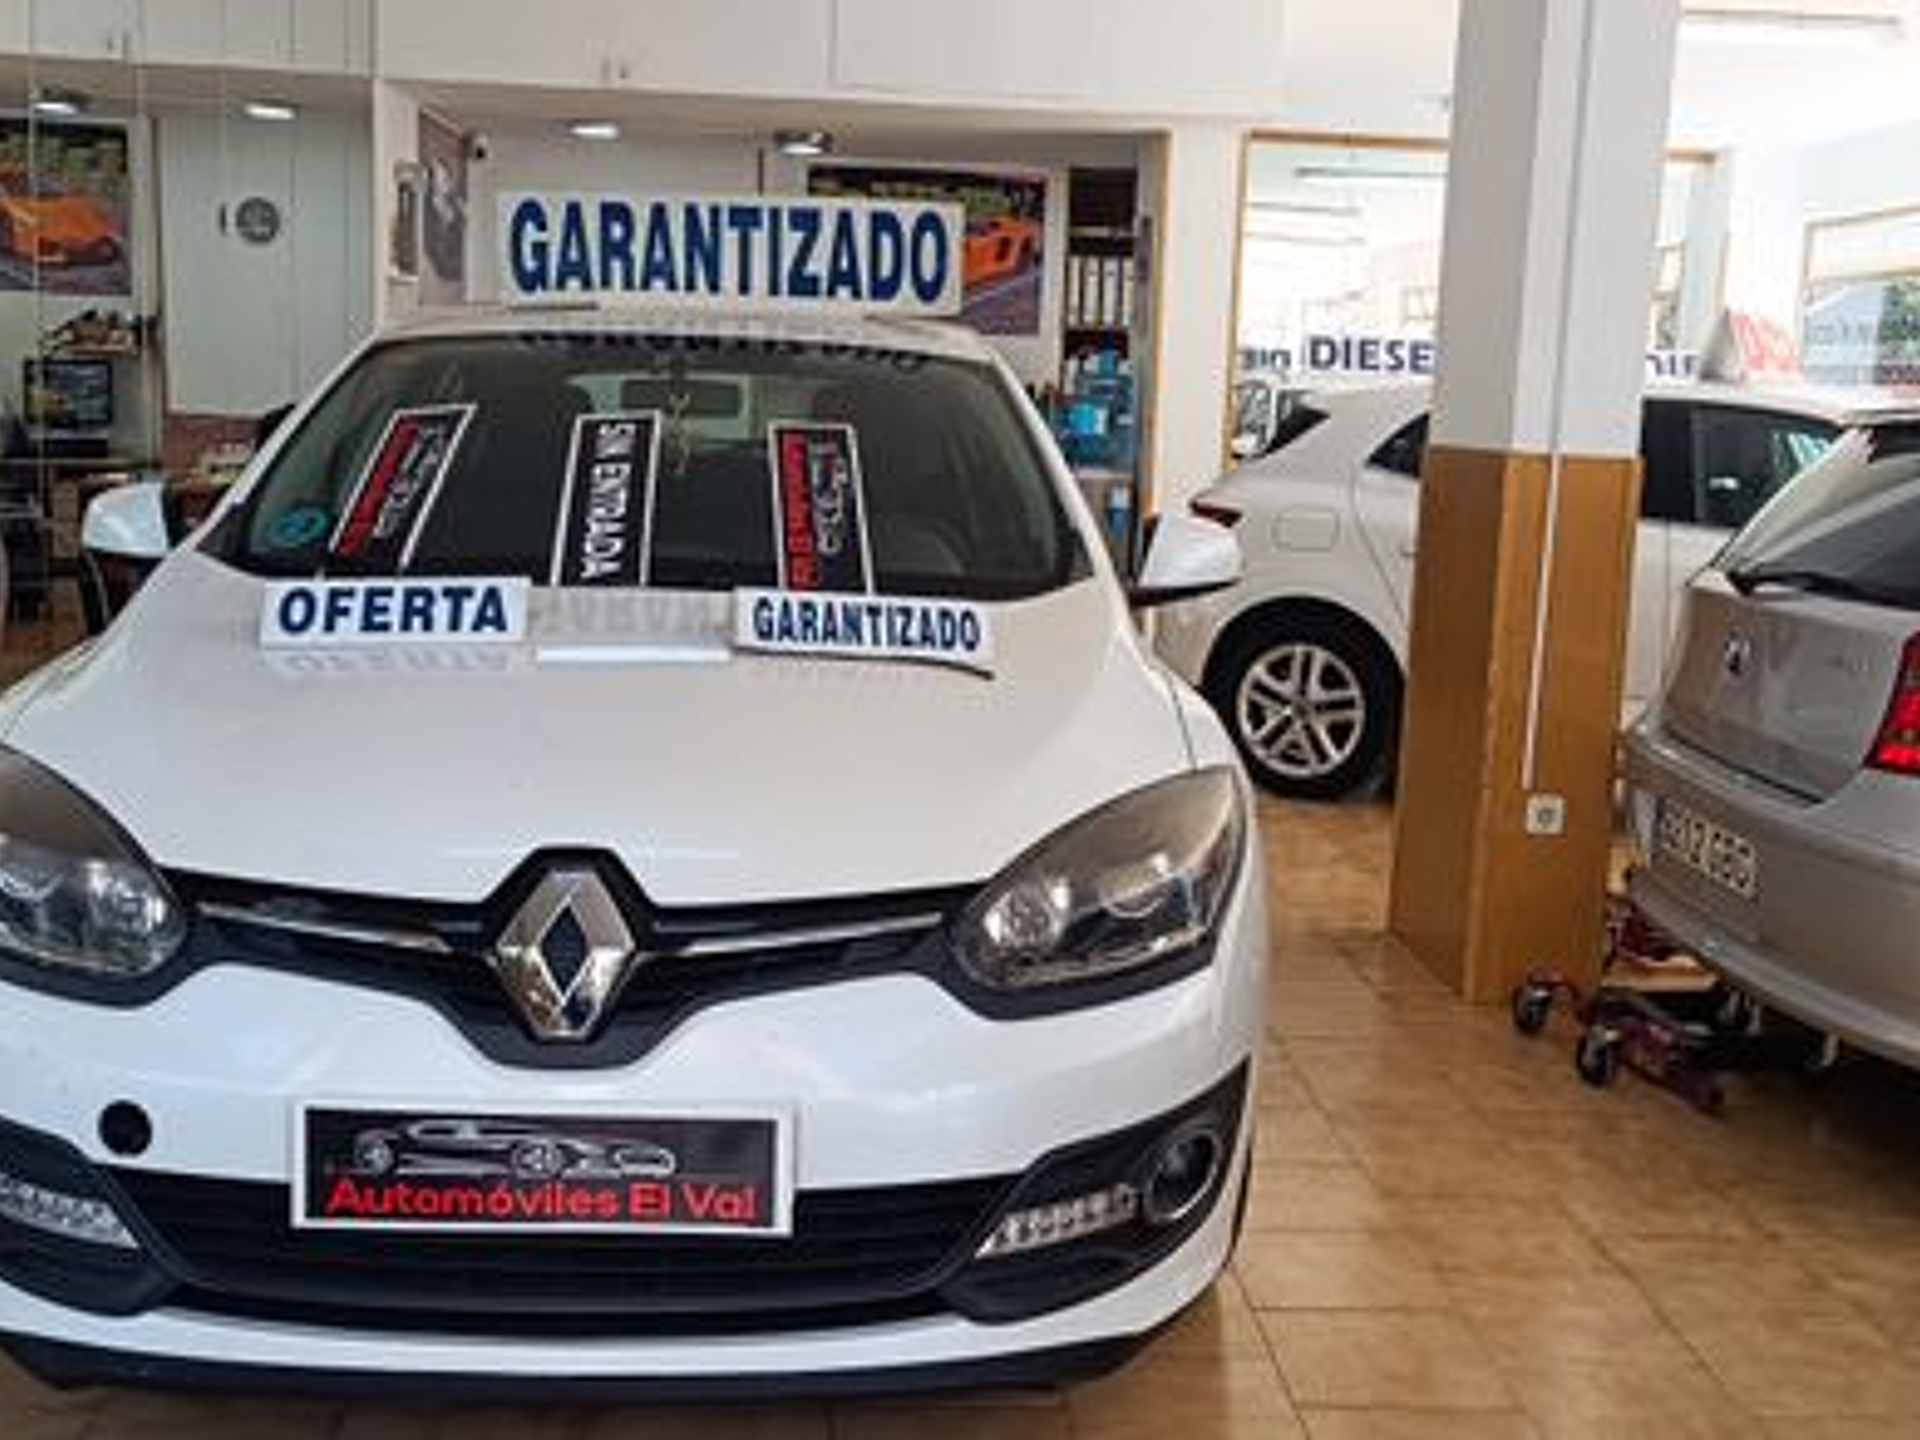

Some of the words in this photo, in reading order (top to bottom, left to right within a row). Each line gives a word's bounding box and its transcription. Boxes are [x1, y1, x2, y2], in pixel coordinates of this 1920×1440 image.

[510, 197, 948, 302] GARANTIZADO
[579, 462, 631, 579] ENTRADA
[278, 586, 508, 635] OFERTA
[753, 596, 982, 651] GARANTIZADO
[325, 1177, 621, 1218] Automóviles
[629, 1181, 671, 1219] El
[681, 1182, 757, 1220] Val
